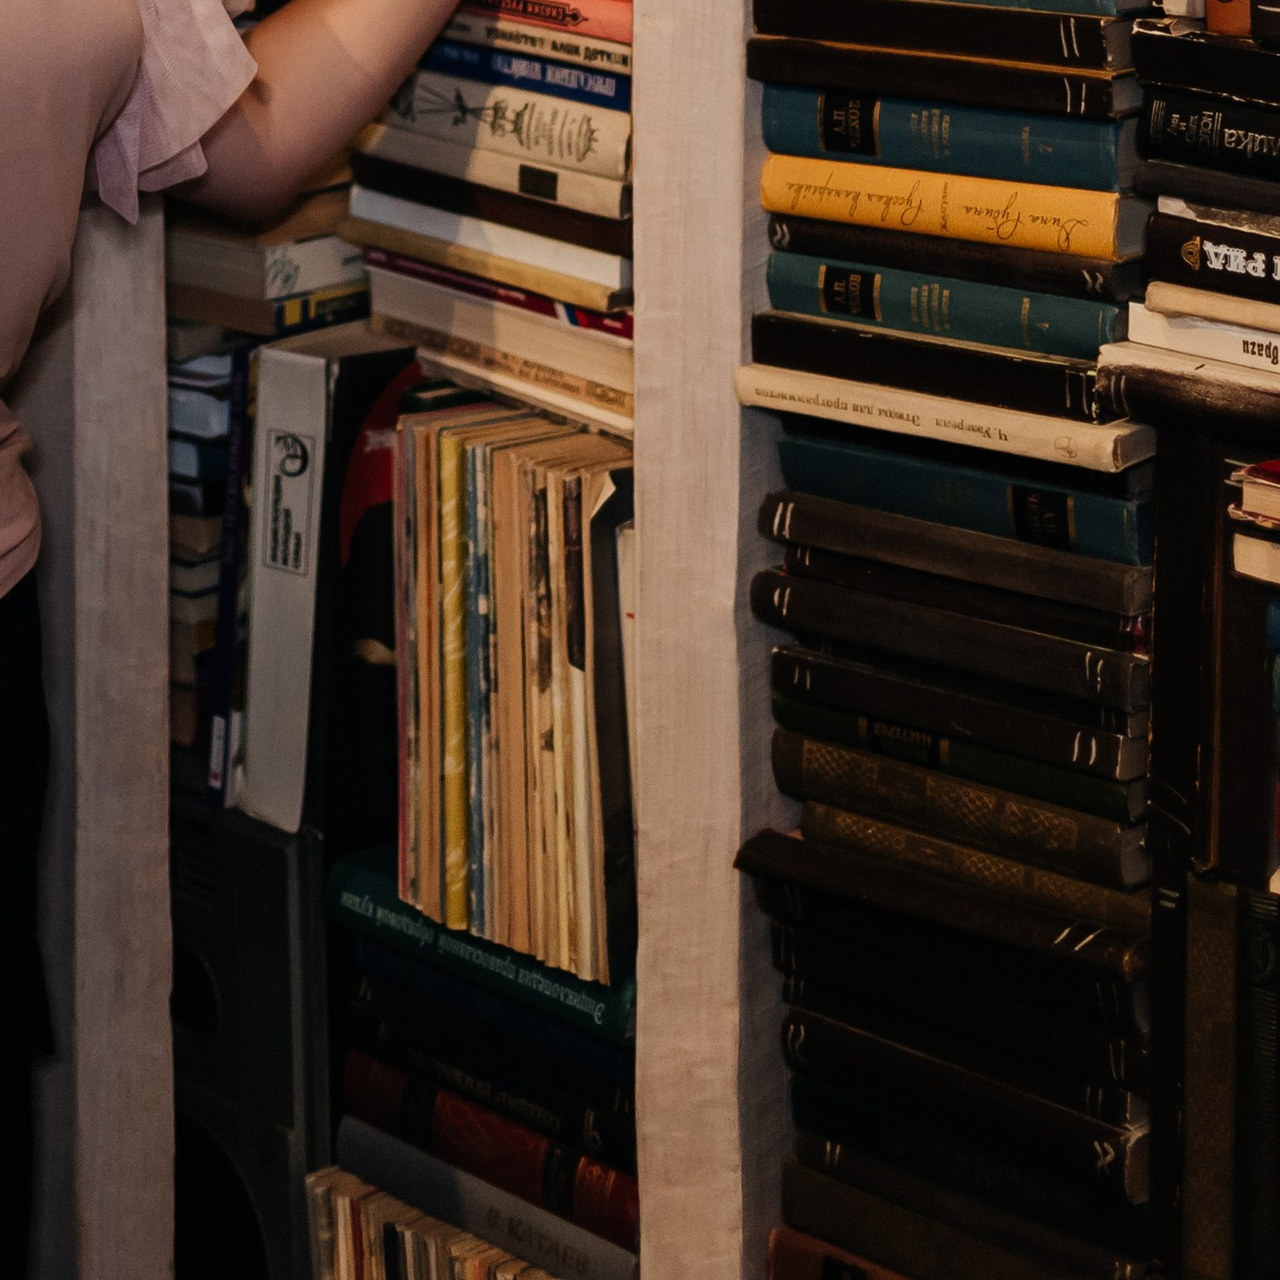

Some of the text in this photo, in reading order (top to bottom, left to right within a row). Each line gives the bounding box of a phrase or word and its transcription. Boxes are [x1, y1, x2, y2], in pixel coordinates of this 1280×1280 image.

[961, 191, 1021, 240] Рубина
[1029, 213, 1089, 251] Дина
[1202, 240, 1266, 278] РИД
[851, 402, 874, 416] для
[877, 406, 921, 427] Этюды
